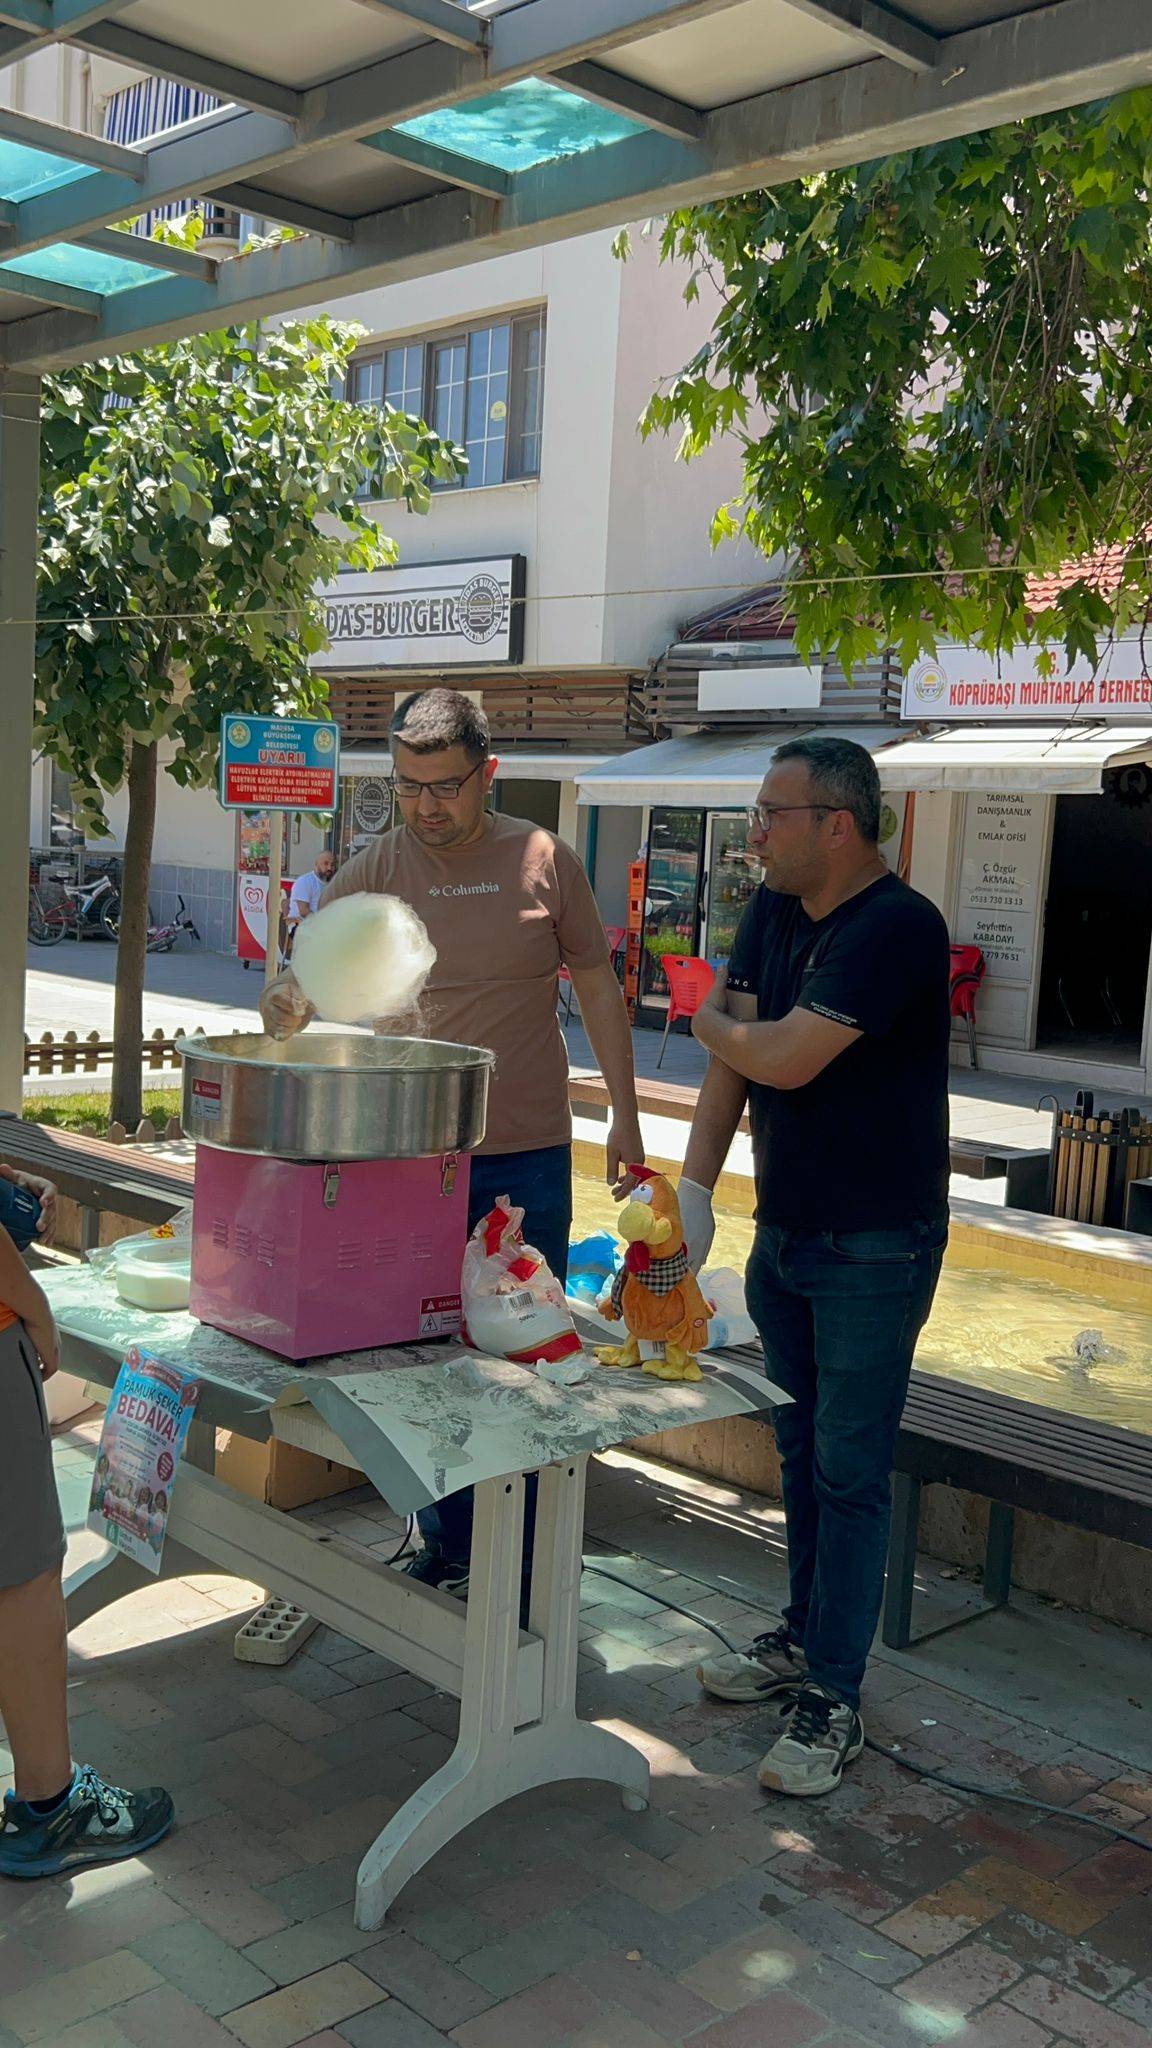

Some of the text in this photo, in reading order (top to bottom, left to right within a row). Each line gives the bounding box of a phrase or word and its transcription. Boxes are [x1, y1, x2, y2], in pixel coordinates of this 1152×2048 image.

[326, 597, 456, 637] DAS BURGER
[949, 679, 1016, 710] KÖPRÜBAŞI
[1020, 681, 1095, 704] MUHTARLAR
[986, 793, 1025, 803] TARIMSAL
[977, 806, 1032, 817] DANIŞMANLIK
[999, 819, 1006, 829] &
[978, 832, 1026, 842] EMLAK OFİSİ
[993, 862, 1017, 875] Özgür
[982, 874, 1015, 885] AKMAN
[442, 882, 500, 897] Columbia
[976, 920, 1013, 932] Seyfettin
[973, 932, 1015, 944] KABADAYI
[124, 1379, 183, 1420] PAMUK ŞEKER
[116, 1394, 180, 1443] BEDAVA!
